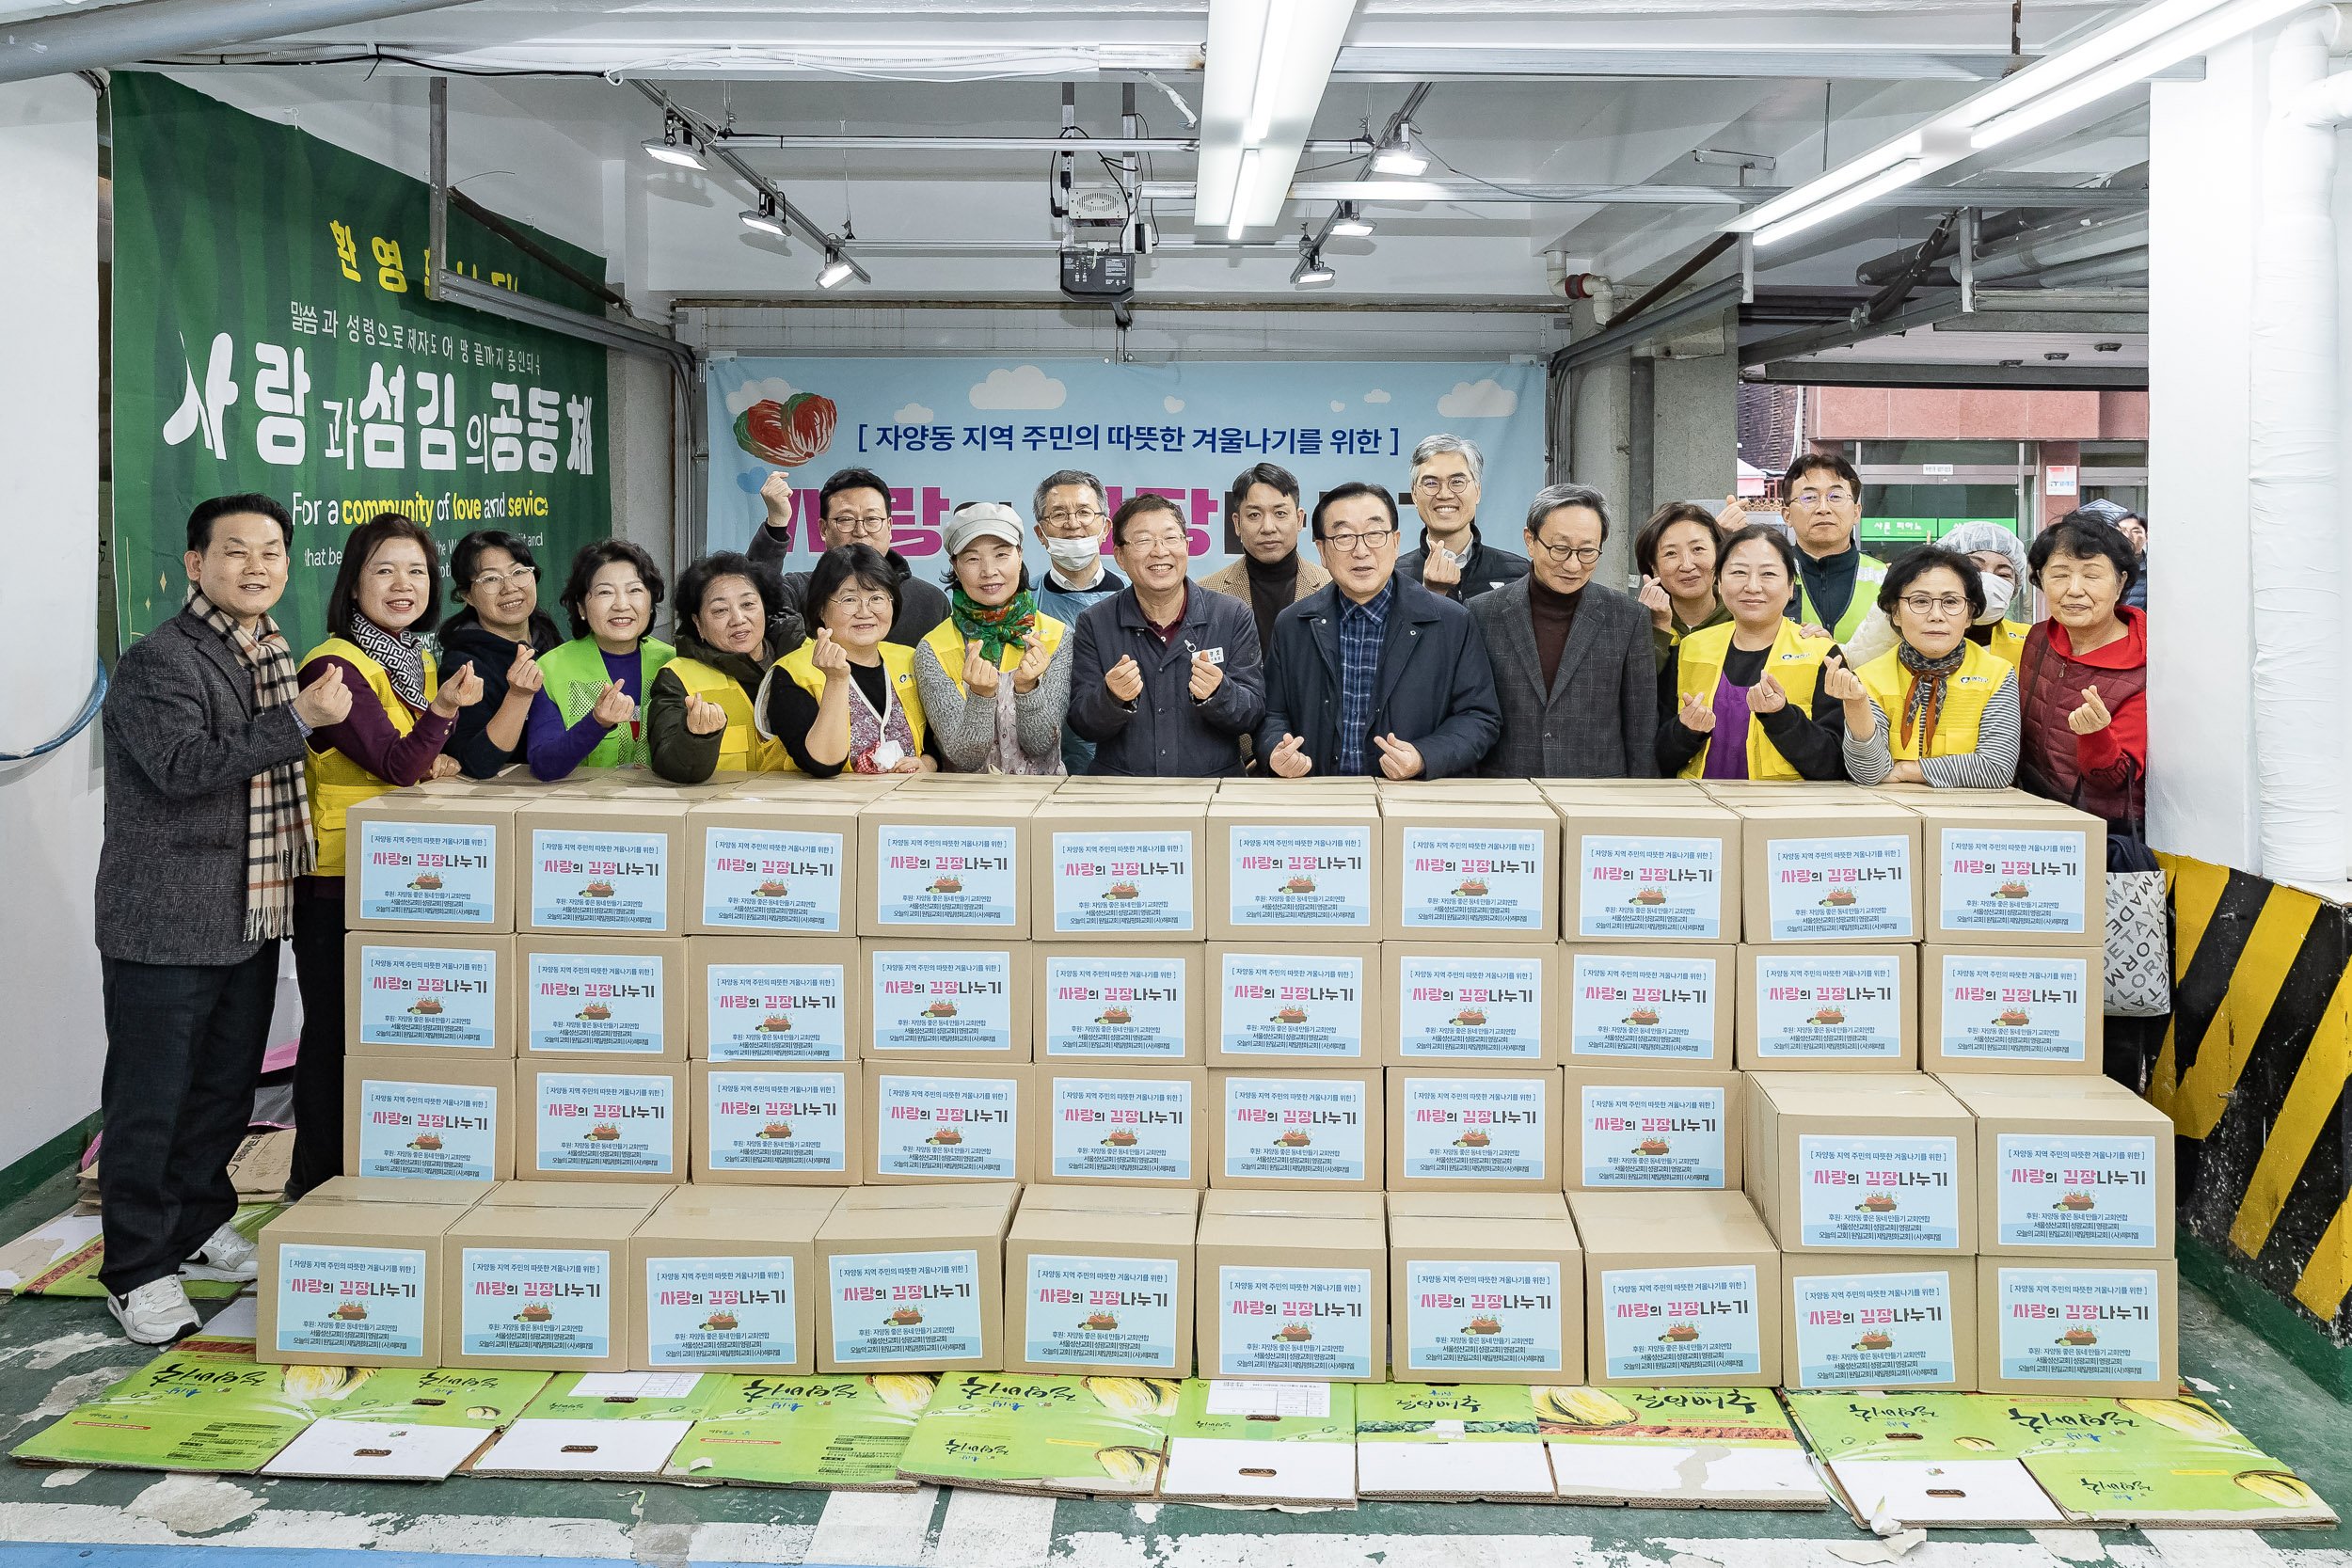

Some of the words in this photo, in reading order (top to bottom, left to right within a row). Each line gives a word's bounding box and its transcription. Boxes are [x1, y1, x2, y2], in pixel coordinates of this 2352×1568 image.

[875, 424, 956, 451] 자양동
[962, 424, 1014, 452] 지역
[1022, 424, 1100, 451] 주민의
[1107, 424, 1186, 455] 따뜻한
[1193, 426, 1324, 455] 겨울나기를
[1329, 427, 1383, 455] 위한
[293, 491, 322, 526] For
[327, 499, 339, 525] a
[342, 491, 435, 528] community
[437, 491, 451, 521] of
[453, 492, 482, 520] love
[373, 852, 412, 865] 사랑의
[417, 854, 486, 868] 김장나누기
[717, 858, 756, 872] 사랑의
[761, 861, 833, 876] 김장나누기
[891, 856, 930, 869] 사랑의
[935, 857, 1007, 870] 김장나누기
[1416, 859, 1455, 872] 사랑의
[1461, 860, 1534, 873] 김장나누기
[1954, 860, 1995, 874] 사랑의
[2001, 862, 2076, 876] 김장나누기
[1066, 863, 1105, 877] 사랑의
[1111, 861, 1184, 877] 김장나누기
[1781, 869, 1822, 884] 사랑의
[1828, 866, 1901, 882] 김장나누기
[373, 976, 412, 990] 사랑의
[417, 978, 486, 993] 김장나누기
[541, 983, 580, 996] 사랑의
[584, 984, 654, 997] 김장나누기
[721, 995, 759, 1008] 사랑의
[765, 995, 835, 1009] 김장나누기
[1059, 987, 1099, 1000] 사랑의
[1104, 988, 1176, 1001] 김장나누기
[1413, 988, 1454, 1001] 사랑의
[1459, 989, 1533, 1002] 김장나누기
[1586, 987, 1627, 1000] 사랑의
[1632, 989, 1706, 1003] 김장나누기
[1955, 988, 1996, 1001] 사랑의
[2002, 989, 2076, 1003] 김장나누기
[549, 1103, 588, 1117] 사랑의
[594, 1105, 664, 1118] 김장나누기
[891, 1107, 930, 1120] 사랑의
[936, 1108, 1008, 1122] 김장나누기
[1238, 1109, 1278, 1122] 사랑의
[1283, 1110, 1356, 1124] 김장나누기
[373, 1111, 412, 1126] 사랑의
[417, 1114, 487, 1130] 김장나누기
[1595, 1117, 1635, 1131] 사랑의
[1642, 1118, 1715, 1132] 김장나누기
[1814, 1170, 1859, 1185] 사랑의
[1866, 1171, 1947, 1186] 김장나누기
[2012, 1169, 2057, 1183] 사랑의
[2063, 1170, 2145, 1184] 김장나누기
[292, 1278, 334, 1293] 사랑의
[340, 1281, 416, 1297] 김장나누기
[476, 1282, 517, 1295] 사랑의
[524, 1283, 600, 1297] 김장나누기
[844, 1286, 886, 1302] 사랑의
[892, 1282, 970, 1301] 김장나누기
[660, 1291, 703, 1306] 사랑의
[708, 1289, 785, 1306] 김장나누기
[1040, 1289, 1083, 1304] 사랑의
[1089, 1291, 1168, 1307] 김장나누기
[1421, 1294, 1465, 1308] 사랑의
[1471, 1294, 1550, 1309] 김장나누기
[1233, 1301, 1277, 1315] 사랑의
[1282, 1302, 1361, 1317] 김장나누기
[1617, 1302, 1661, 1319] 사랑의
[1667, 1299, 1748, 1317] 김장나누기
[1809, 1309, 1854, 1326] 사랑의
[1860, 1306, 1941, 1324] 김장나누기
[2013, 1304, 2059, 1319] 사랑의
[2065, 1305, 2148, 1320] 김장나누기
